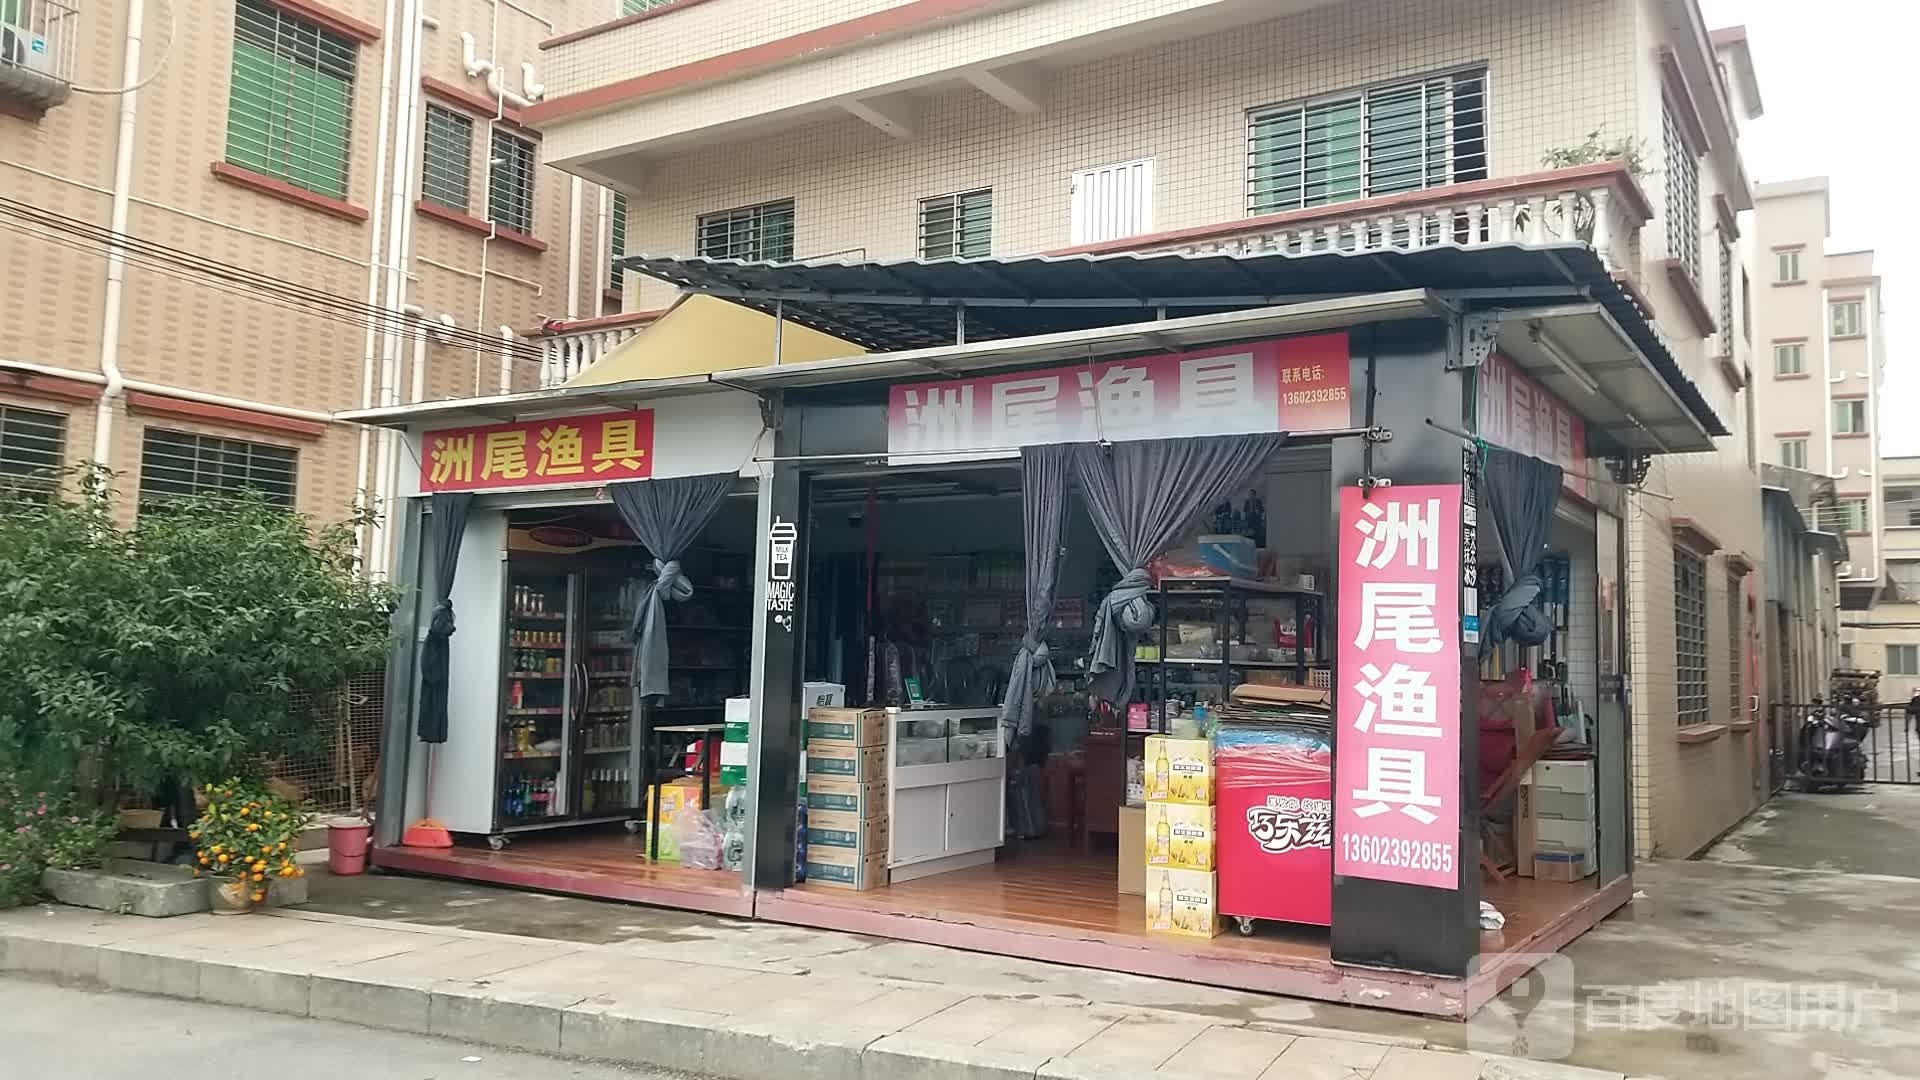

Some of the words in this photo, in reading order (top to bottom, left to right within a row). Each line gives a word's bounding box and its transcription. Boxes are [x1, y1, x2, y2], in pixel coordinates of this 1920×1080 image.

[904, 352, 1262, 446] 洲尾渔具
[1283, 387, 1346, 407] 13602392855
[429, 419, 645, 484] 洲尾渔具
[776, 553, 788, 561] TEA
[767, 581, 795, 600] MAGIC
[767, 599, 794, 612] TASTE
[1352, 498, 1445, 825] 洲尾渔具
[1342, 833, 1452, 873] 13602392855
